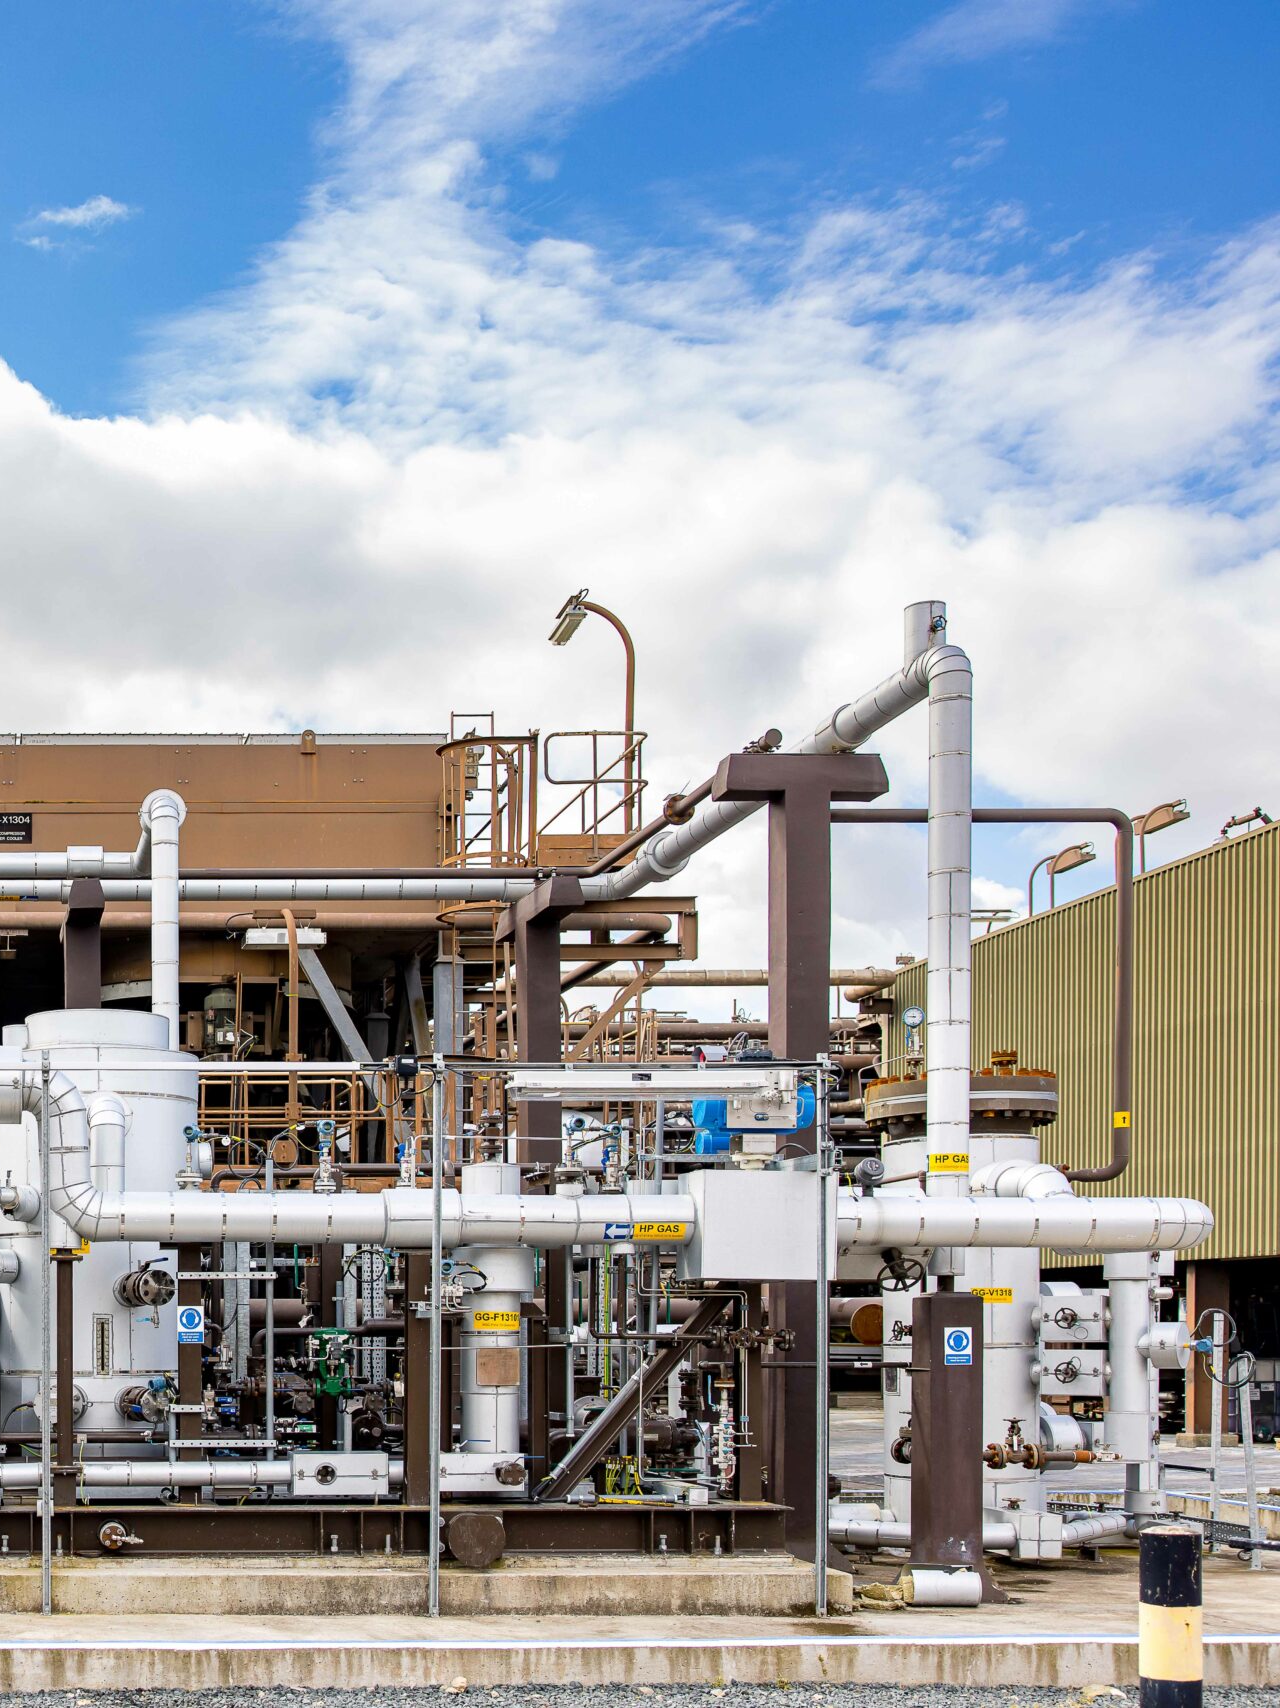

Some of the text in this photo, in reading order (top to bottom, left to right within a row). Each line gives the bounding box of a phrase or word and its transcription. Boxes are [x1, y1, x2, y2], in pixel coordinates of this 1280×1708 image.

[935, 1155, 949, 1163] HP
[639, 1224, 680, 1233] HP GAS
[971, 1288, 1013, 1297] GG-V1318
